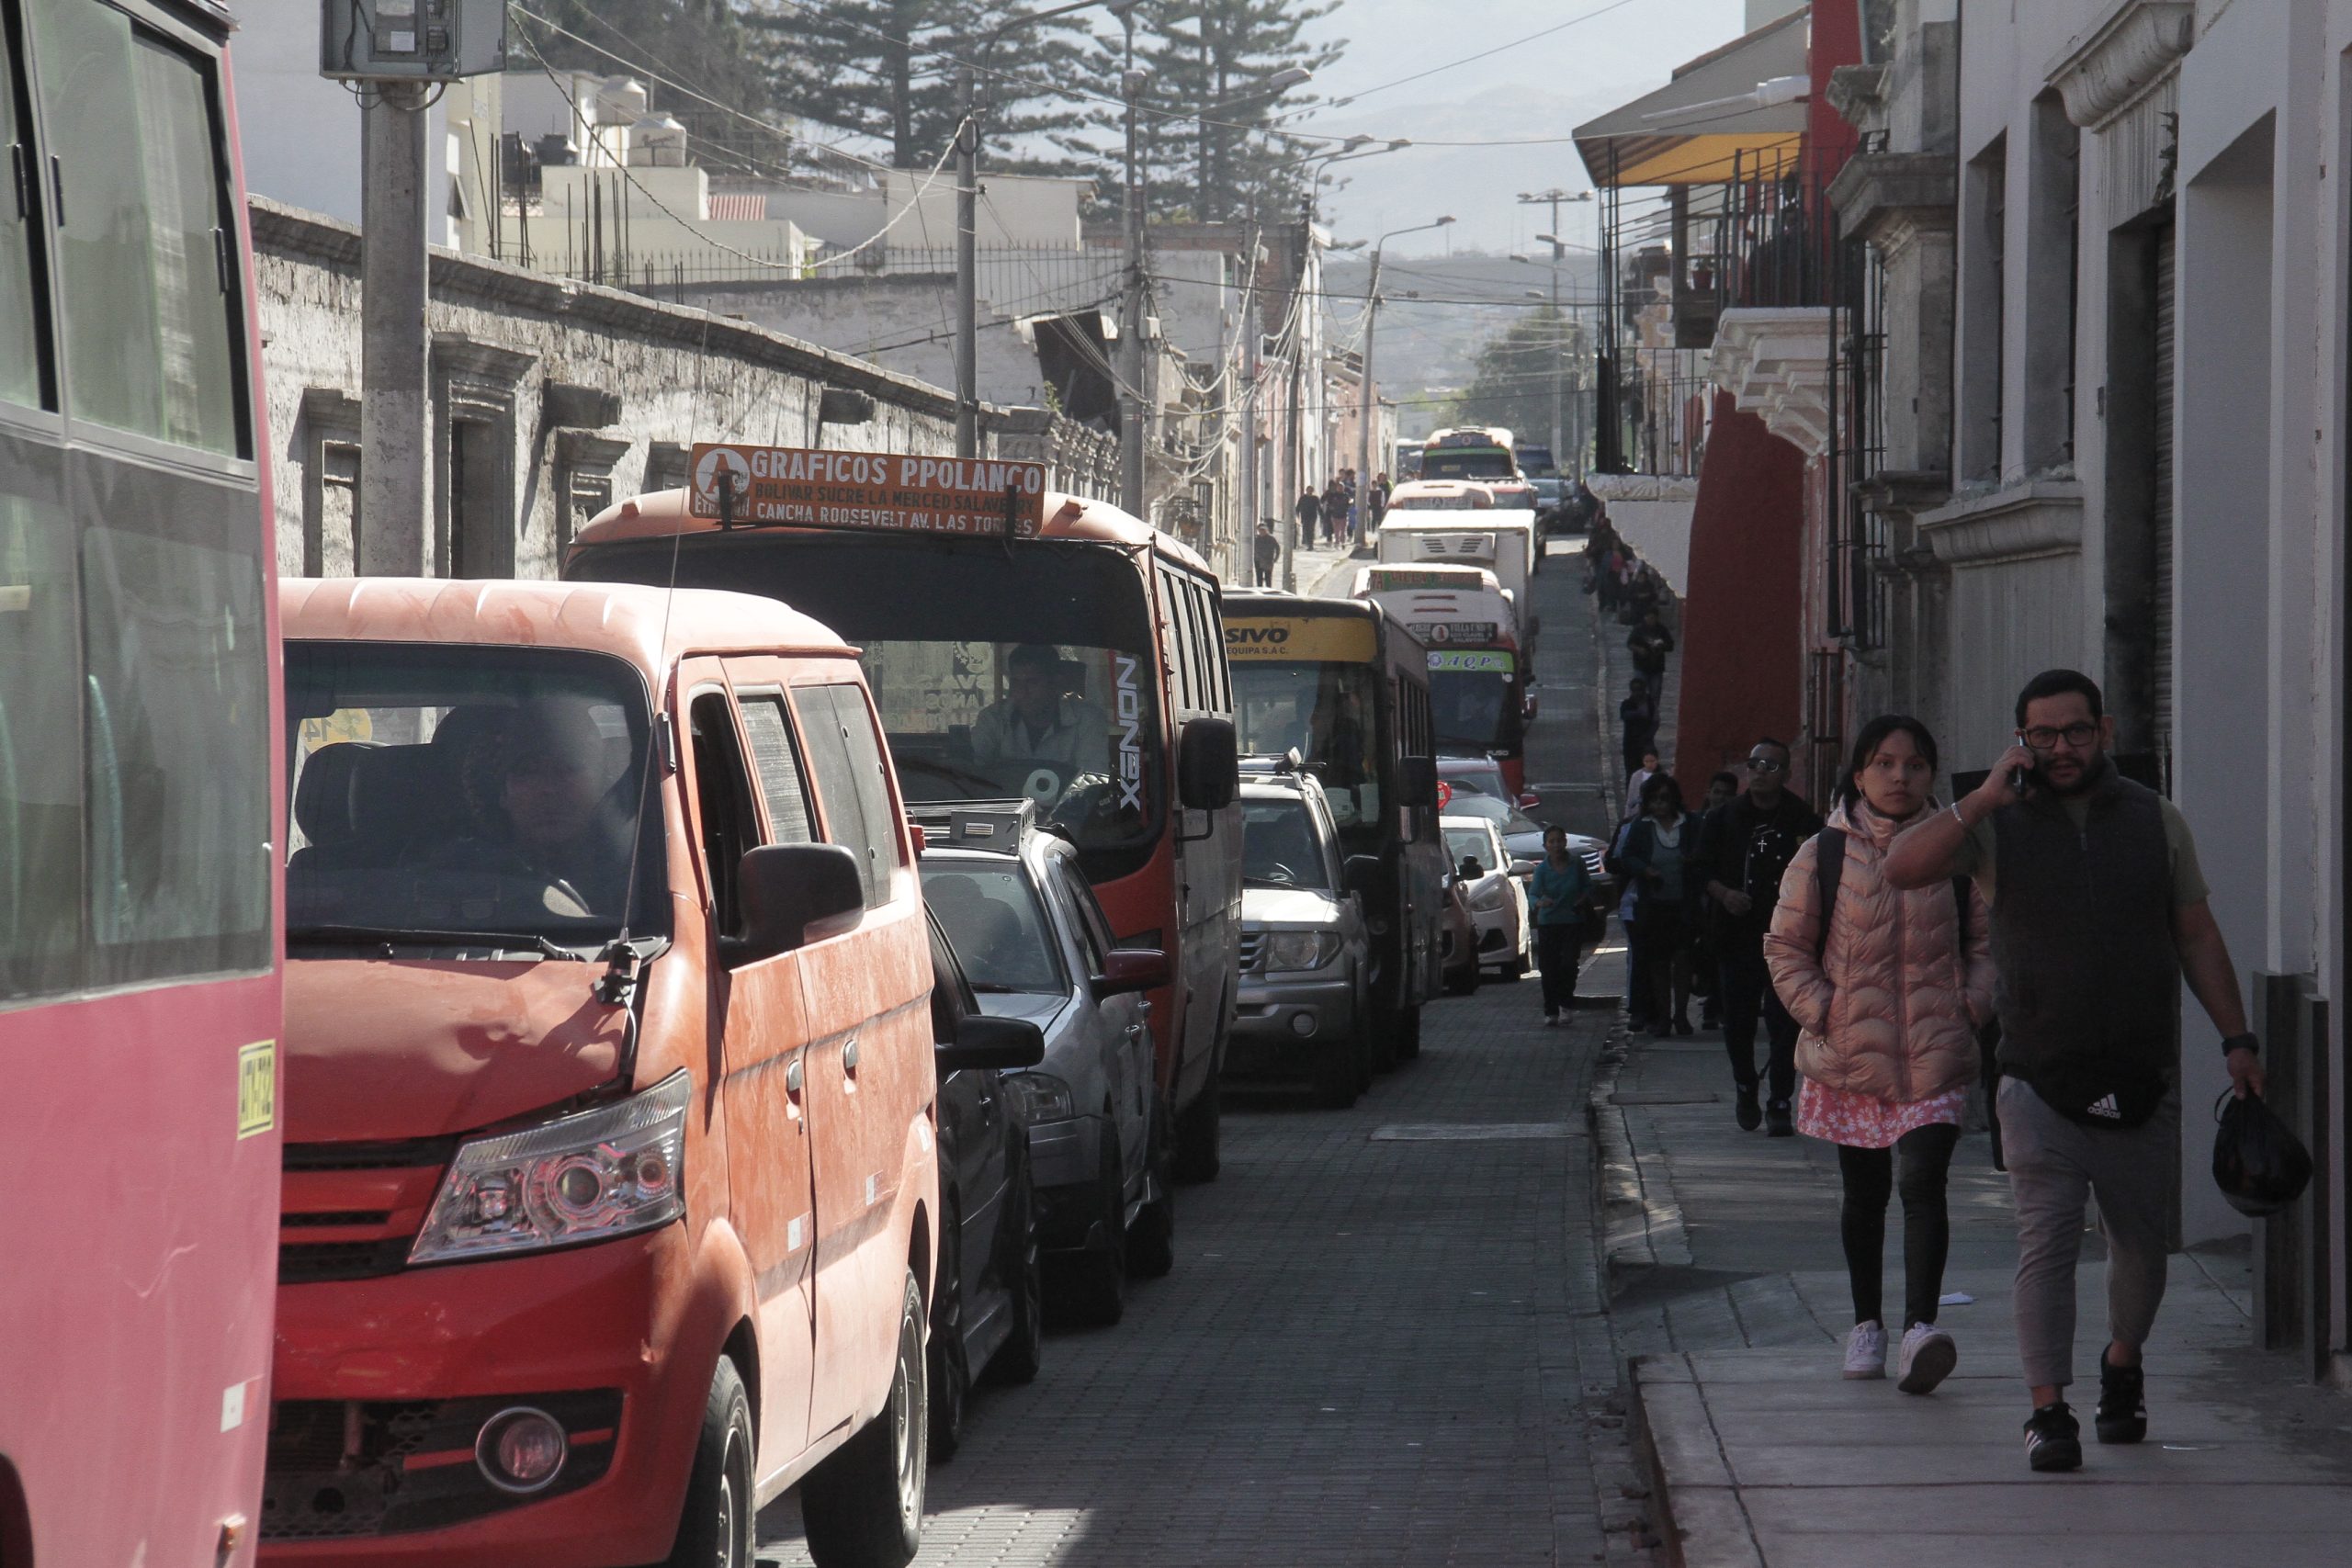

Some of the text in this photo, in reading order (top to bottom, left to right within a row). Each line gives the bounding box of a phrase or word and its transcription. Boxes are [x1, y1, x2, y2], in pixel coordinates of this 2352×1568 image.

[752, 450, 888, 485] GRAFICOS
[755, 482, 1035, 514] BOLIVAR SUCRE LA MERCED SALAVERY
[756, 502, 1034, 535] CANCHA ROOSEVELT AV. LAS TORES
[1115, 655, 1141, 813] XENON
[2086, 1105, 2121, 1120] adidas
